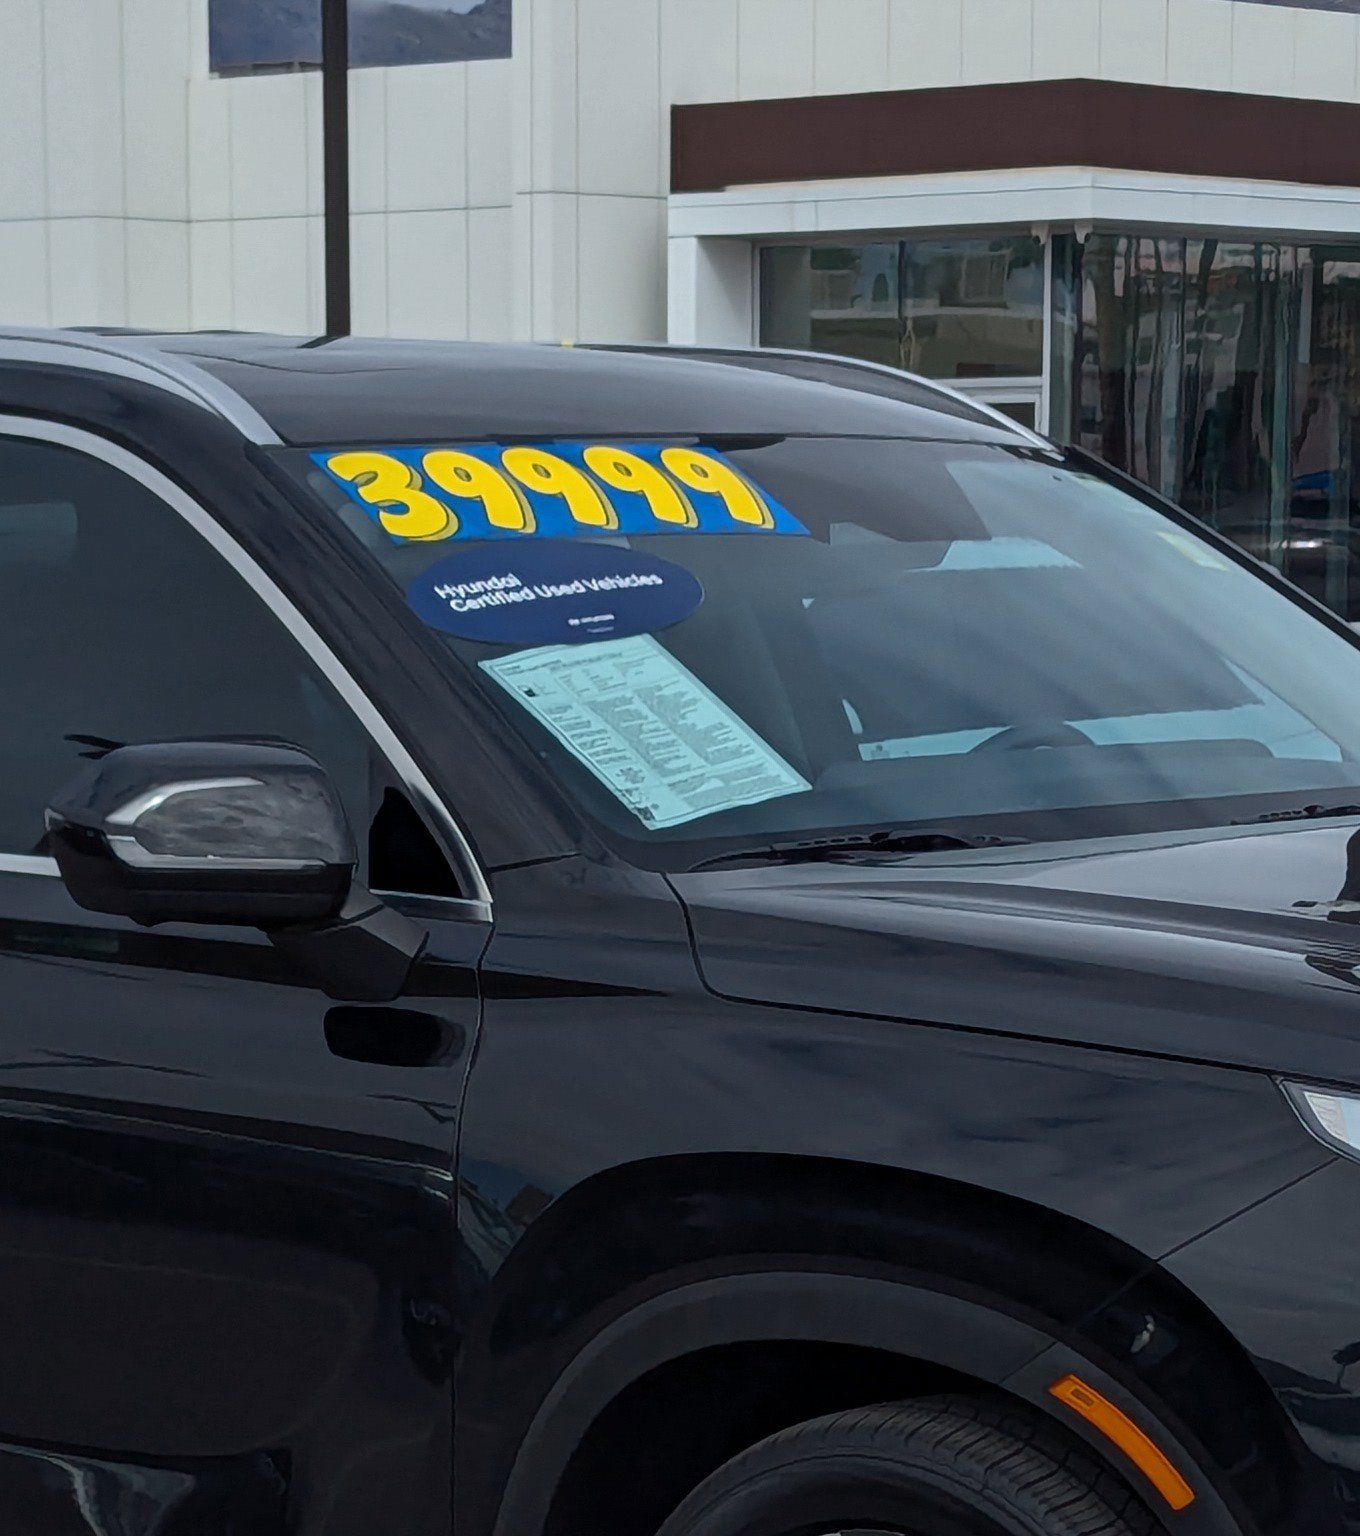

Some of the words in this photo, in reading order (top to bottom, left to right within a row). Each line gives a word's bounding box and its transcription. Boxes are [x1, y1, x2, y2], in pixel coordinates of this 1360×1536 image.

[327, 446, 776, 542] 39999
[434, 573, 522, 599] Hyundai
[450, 590, 536, 612] Certified
[537, 579, 586, 599] Used
[582, 572, 664, 592] Vehicles
